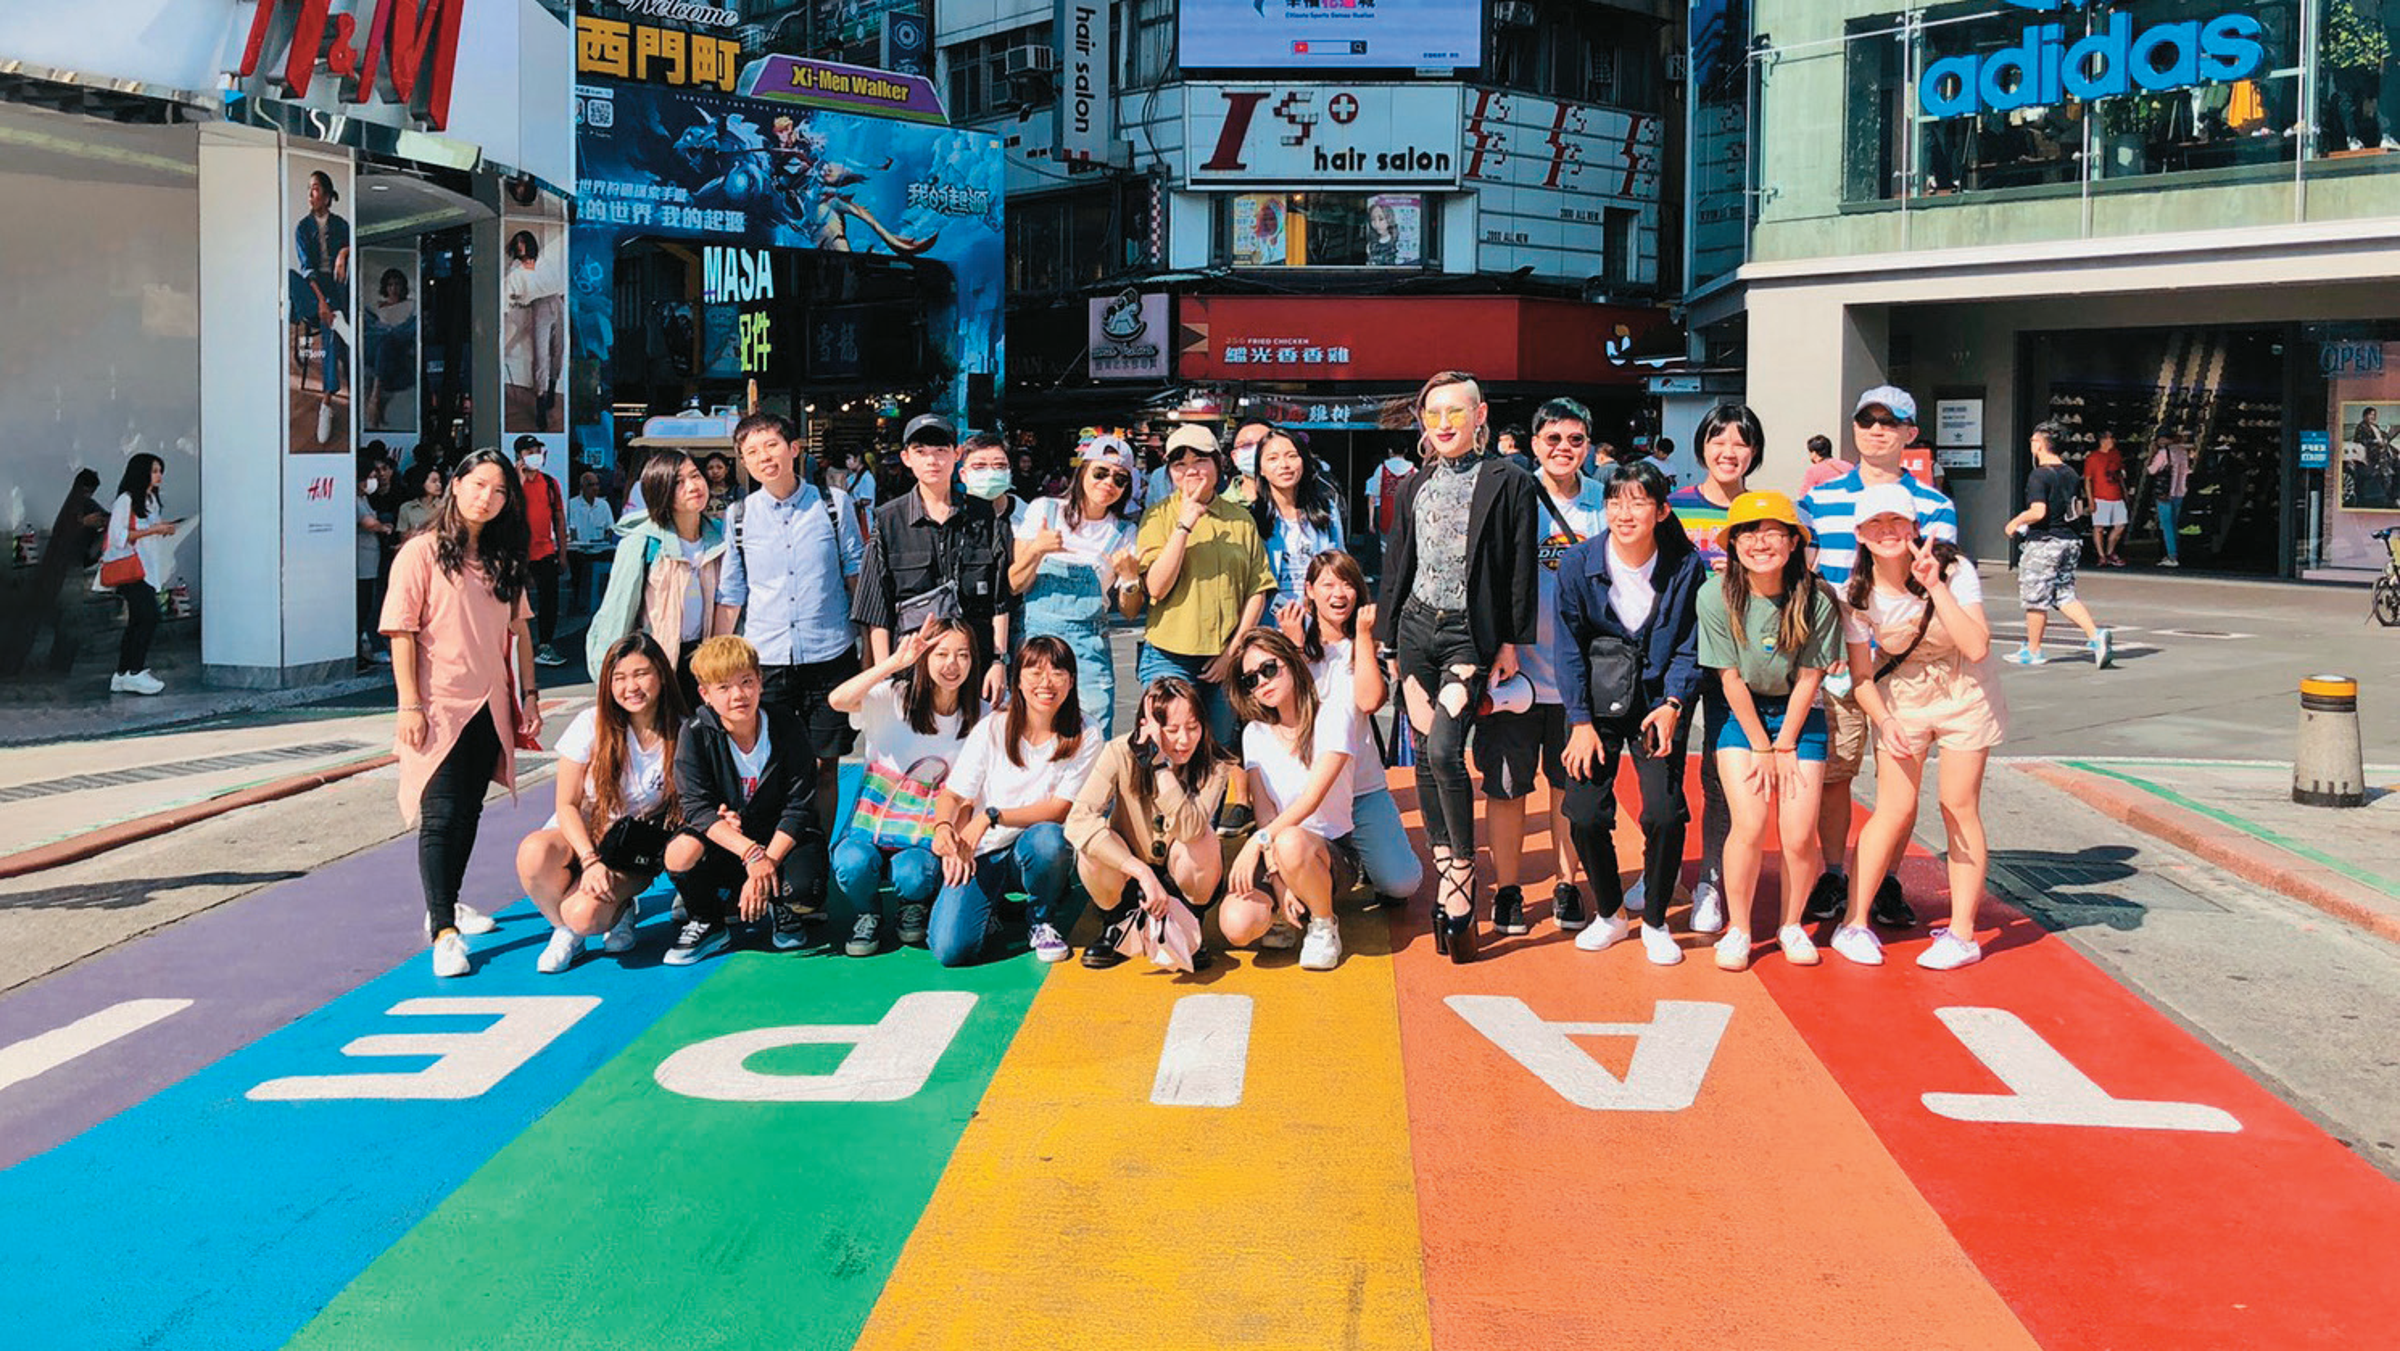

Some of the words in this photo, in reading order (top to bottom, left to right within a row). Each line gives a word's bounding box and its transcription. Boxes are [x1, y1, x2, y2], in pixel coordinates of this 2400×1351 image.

[576, 16, 741, 92] 西門町
[1076, 6, 1096, 57] hair
[791, 65, 850, 93] Xi-Men
[851, 75, 910, 101] Walker
[1919, 12, 2264, 117] adidas
[1075, 62, 1096, 133] salon
[1313, 145, 1367, 172] hair
[1376, 146, 1450, 172] salon
[703, 246, 775, 304] MASA
[1247, 337, 1272, 345] FRIED
[2320, 341, 2382, 373] OPEN
